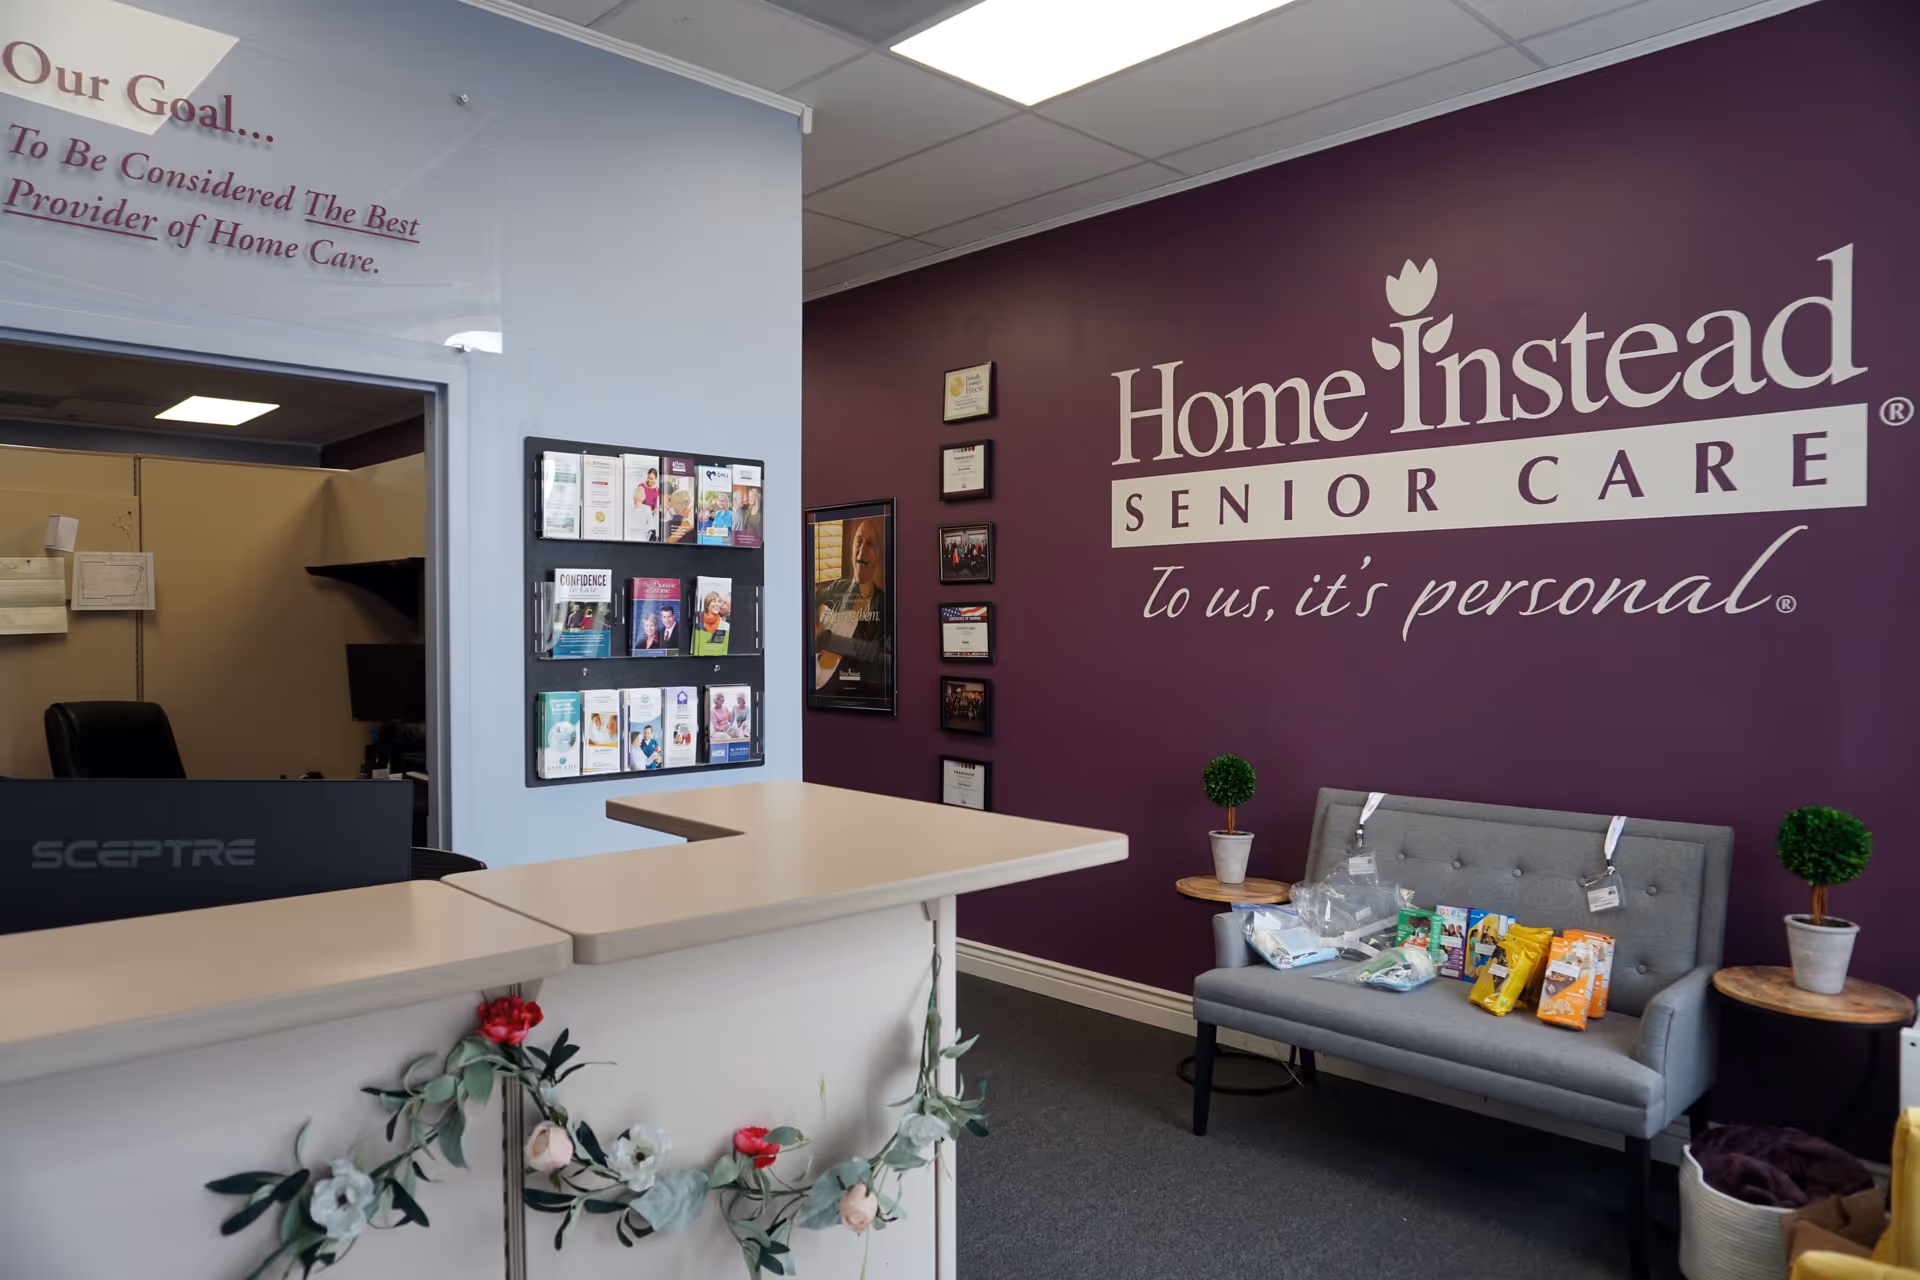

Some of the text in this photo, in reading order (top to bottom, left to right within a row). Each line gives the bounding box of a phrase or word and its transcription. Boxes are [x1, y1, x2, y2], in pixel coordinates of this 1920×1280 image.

[2, 40, 275, 143] Our Goal...
[6, 178, 380, 274] Provider of Home Care.
[8, 124, 420, 236] To Be Considered The Best
[1111, 243, 1868, 466] Home Instead
[1124, 467, 1440, 532] SENIOR
[1517, 430, 1828, 506] CARE
[560, 574, 606, 586] CONFIDENCE
[1143, 565, 1190, 619] To
[1206, 586, 1275, 622] us,
[1295, 556, 1388, 618] it's
[31, 839, 256, 868] SCEPTRE
